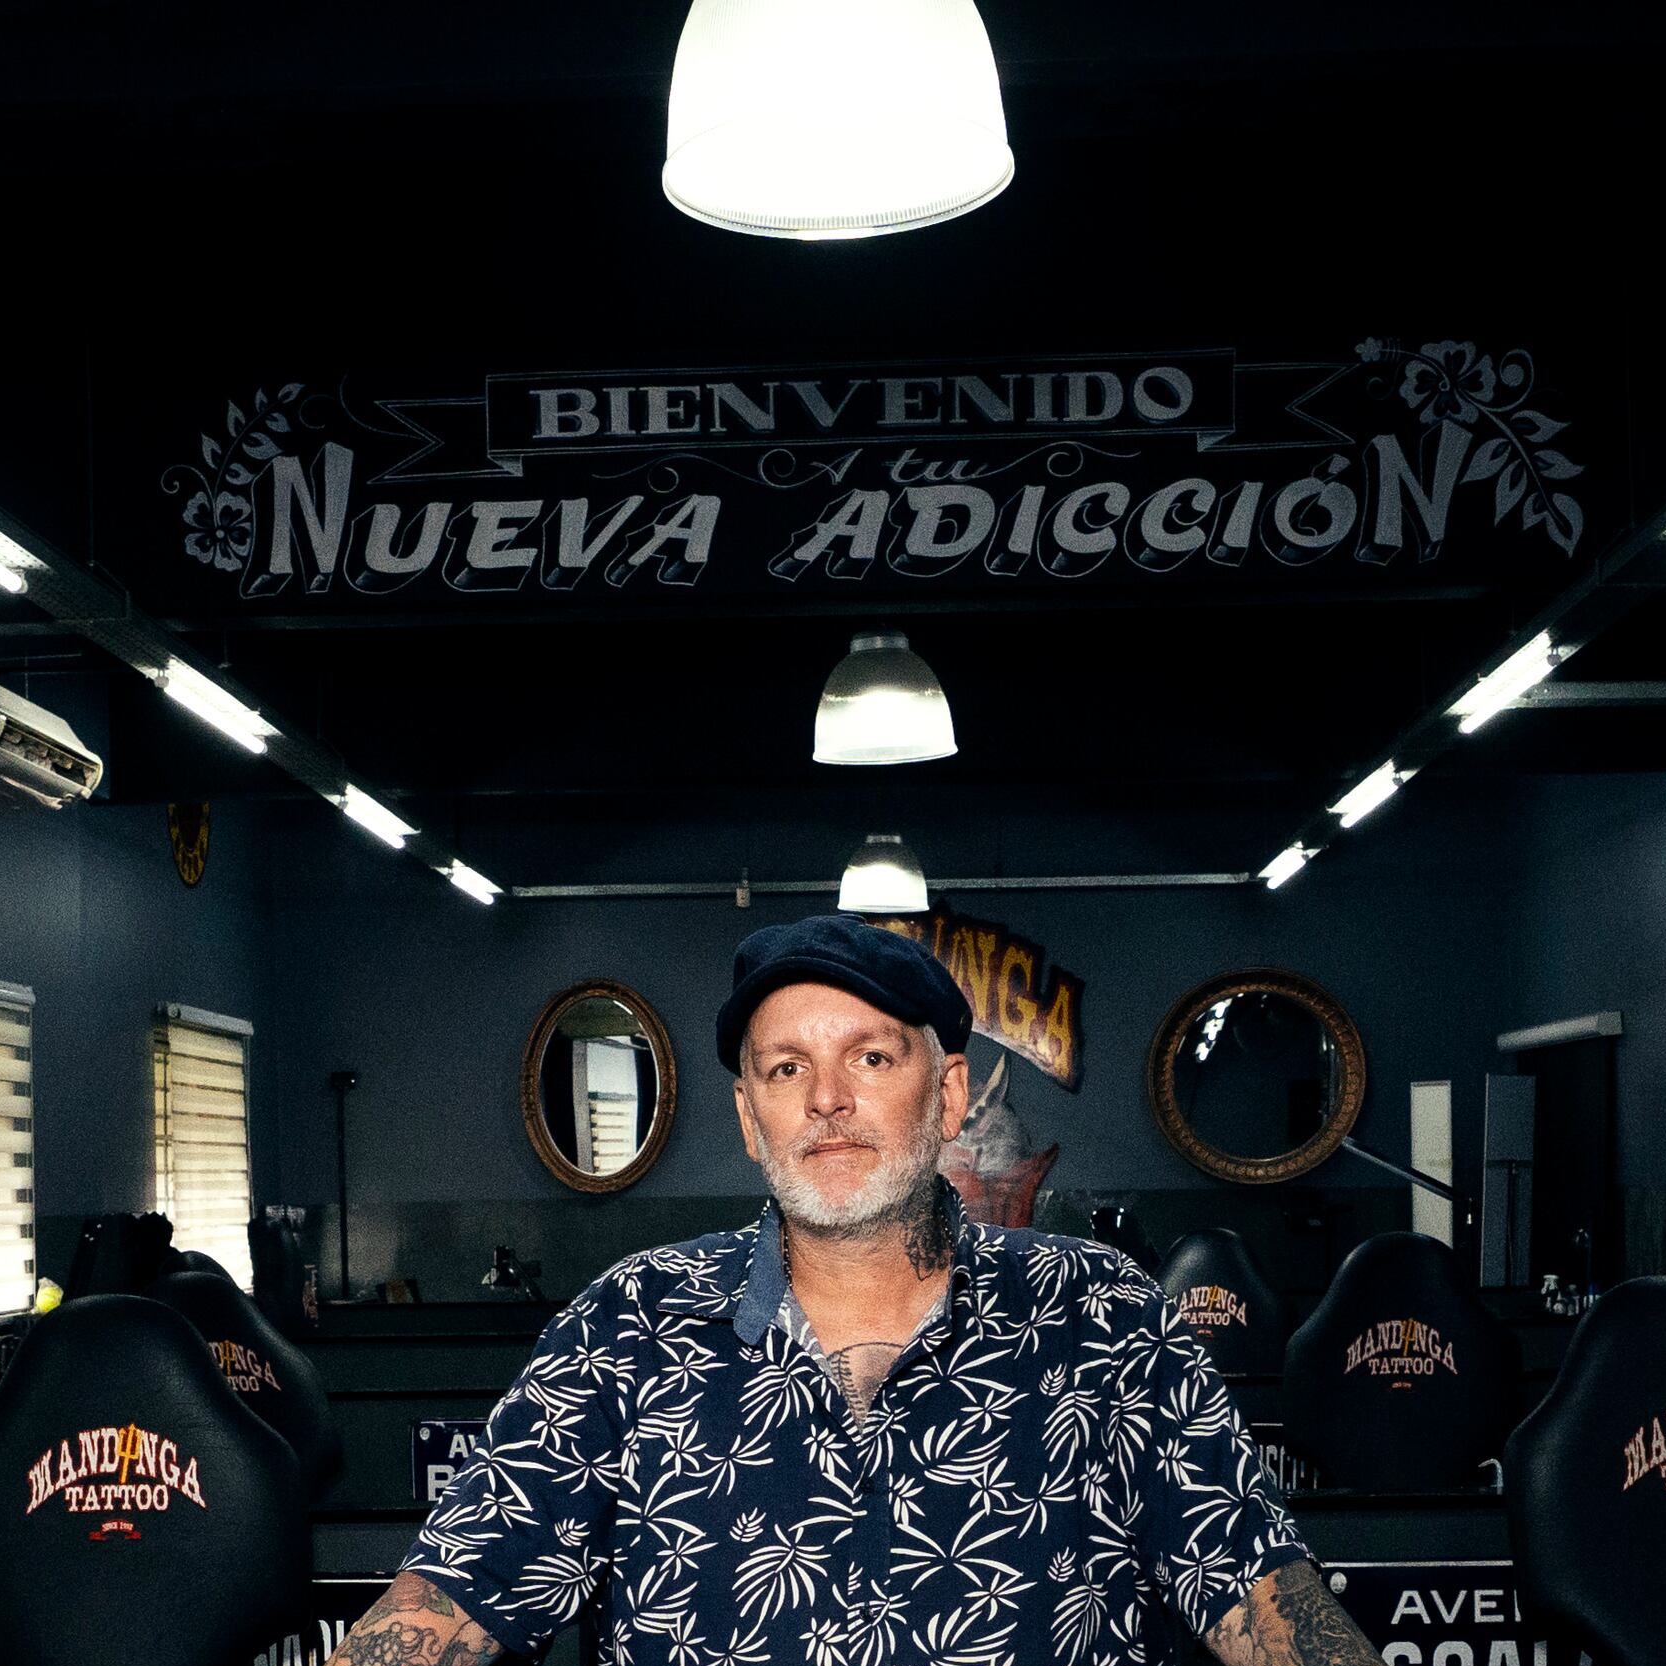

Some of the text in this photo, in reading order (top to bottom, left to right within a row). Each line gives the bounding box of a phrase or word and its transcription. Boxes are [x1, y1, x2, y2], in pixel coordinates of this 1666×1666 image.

[530, 366, 1194, 439] BIENVENIDO
[885, 448, 985, 484] tu
[243, 418, 1475, 598] NUEVA ADICCIÓN
[1179, 1284, 1247, 1327] ANDINGA
[1368, 1356, 1434, 1375] TATTOO
[65, 1483, 170, 1513] TATTOO
[1390, 1589, 1522, 1625] AVE
